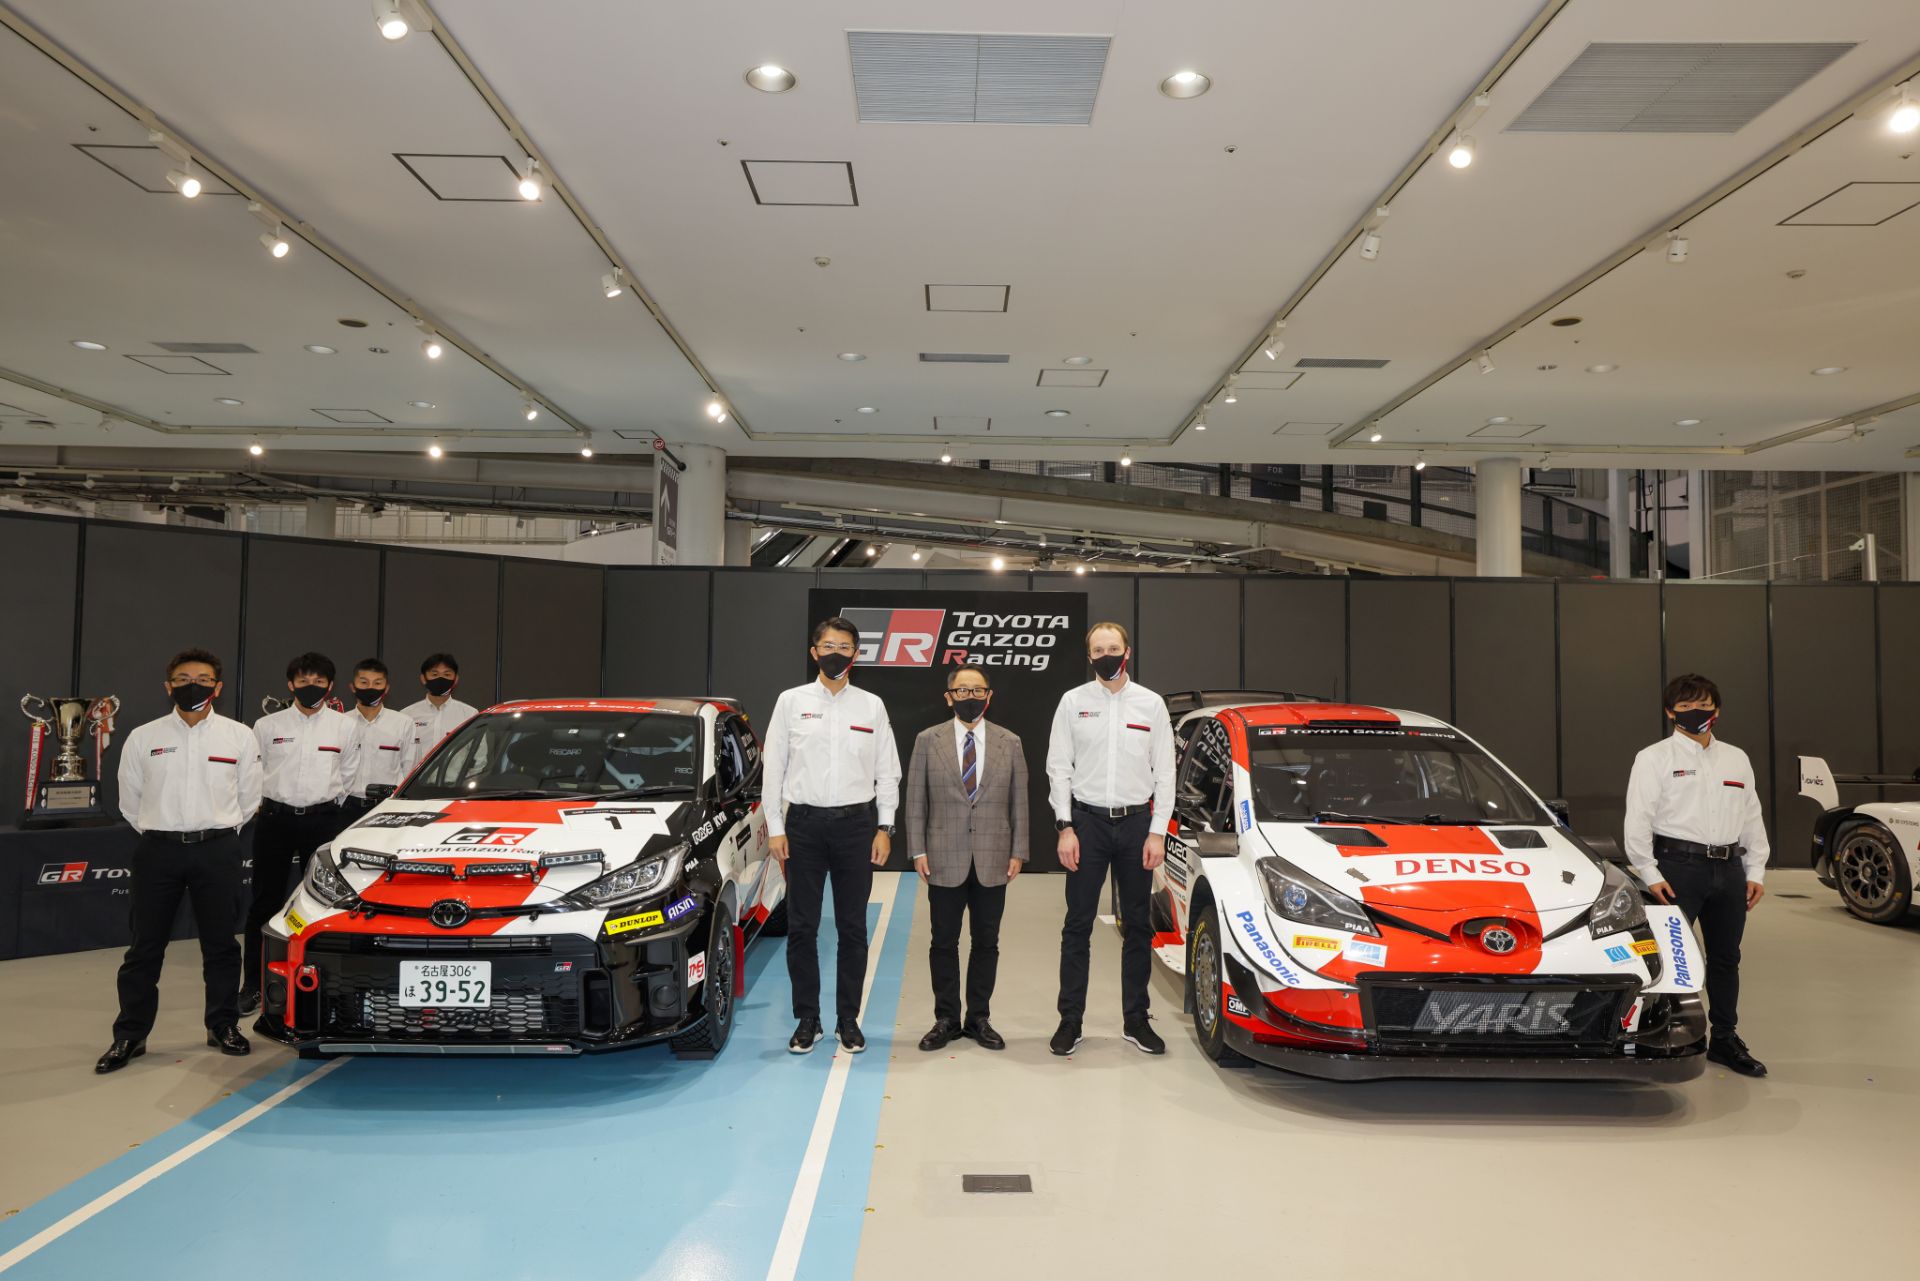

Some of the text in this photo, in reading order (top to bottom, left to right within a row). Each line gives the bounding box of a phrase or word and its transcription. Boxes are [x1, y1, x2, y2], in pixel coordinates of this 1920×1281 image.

[952, 611, 1070, 629] TOYOTA
[947, 630, 1056, 648] GAZOO
[942, 649, 1050, 671] Racing
[604, 816, 622, 830] 1
[445, 833, 526, 845] GR
[511, 847, 551, 855] Racin
[685, 857, 699, 873] PIAA
[1395, 859, 1531, 876] DENSO
[41, 868, 131, 883] GR TOY
[667, 897, 695, 920] AISIN
[620, 915, 659, 928] DUNLOP
[1345, 922, 1370, 934] PIAA
[1596, 925, 1614, 935] PIAA
[1236, 910, 1300, 986] Panasonic
[1296, 936, 1339, 950] PIRELLI
[1665, 916, 1693, 988] Panasonic
[404, 980, 486, 1003] ほ 39-52
